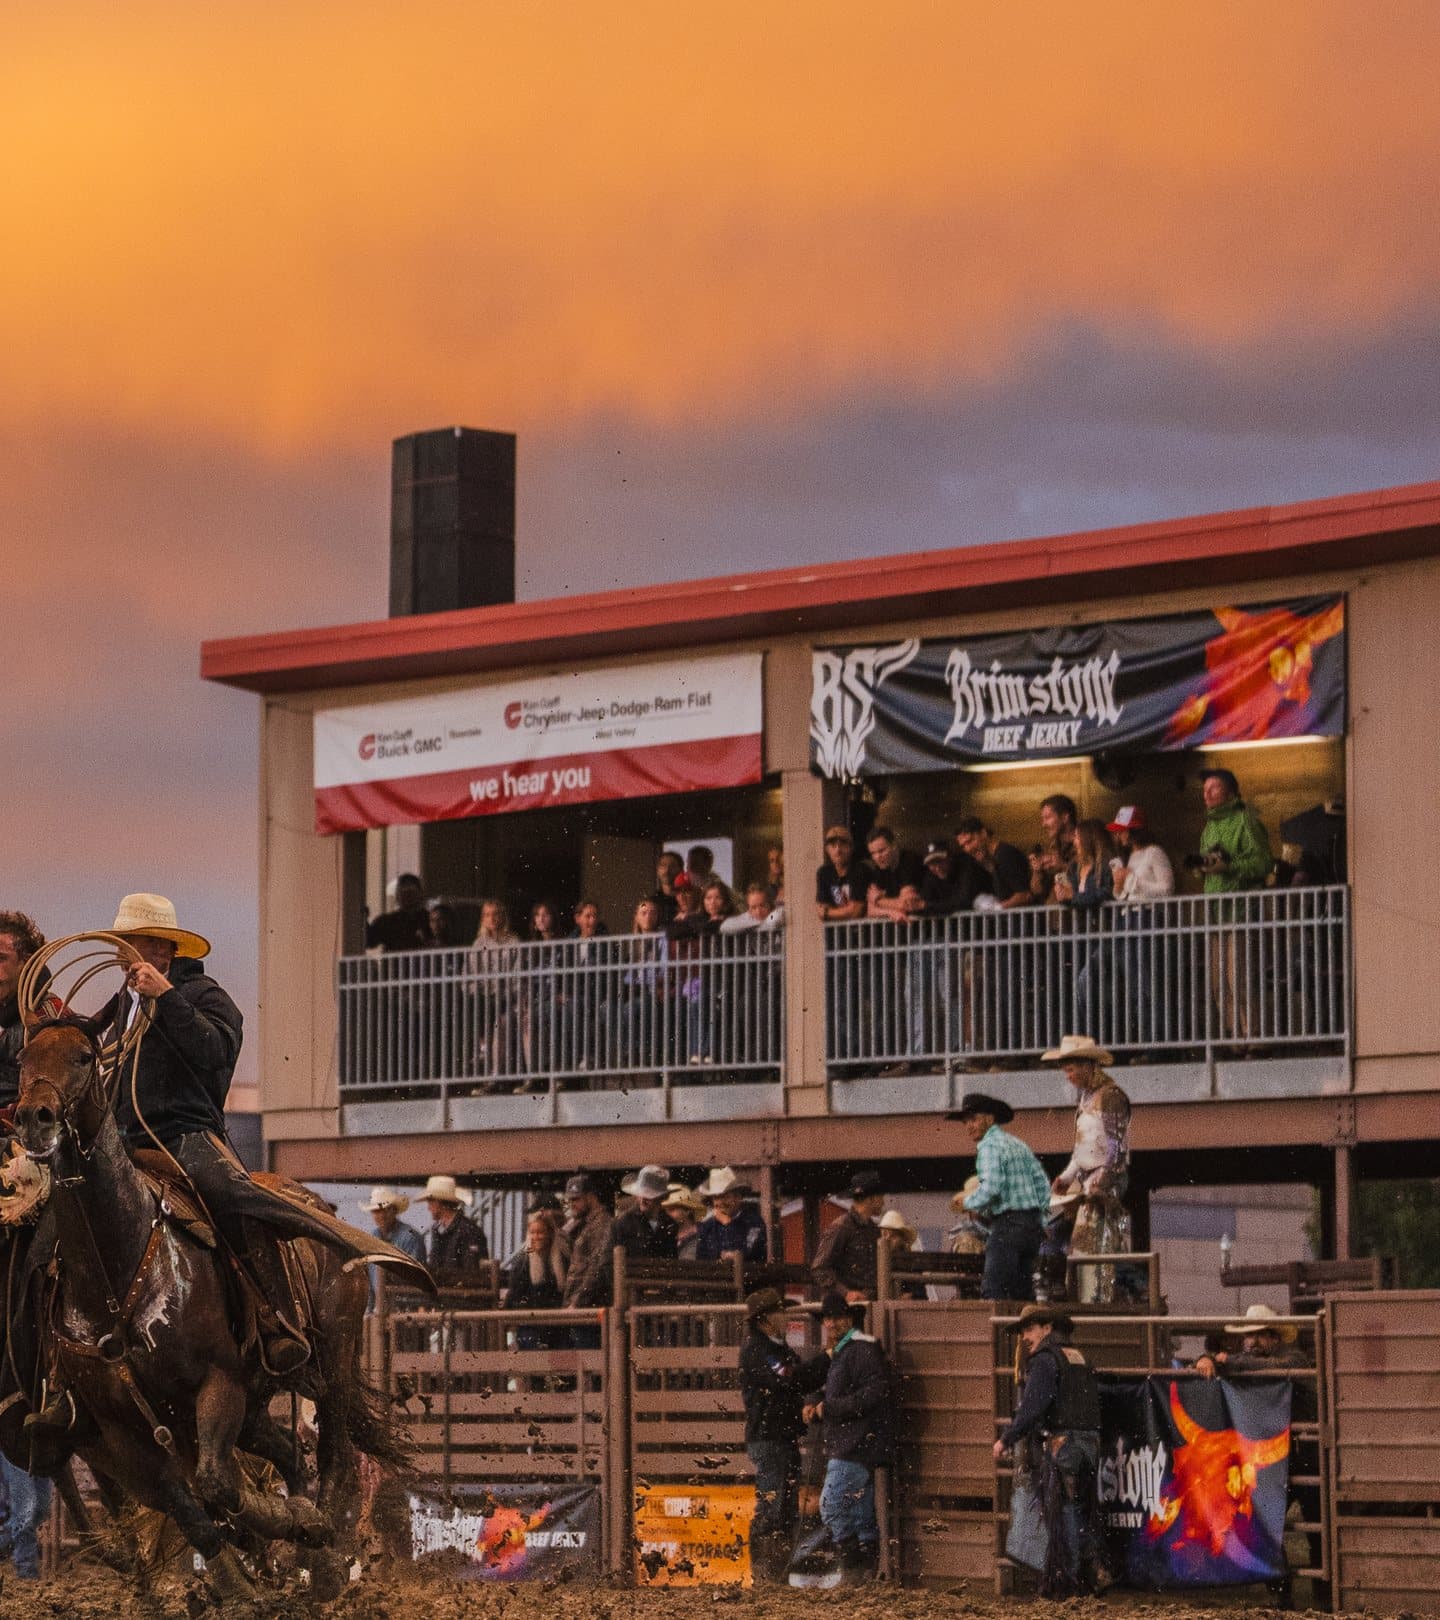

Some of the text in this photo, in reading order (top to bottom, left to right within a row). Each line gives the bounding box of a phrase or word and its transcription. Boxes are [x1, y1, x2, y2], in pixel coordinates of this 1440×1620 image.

[943, 648, 1125, 746] Brimstone
[413, 737, 443, 754] GMC
[982, 719, 1083, 753] BEEF JERKY
[469, 767, 593, 801] we hear you
